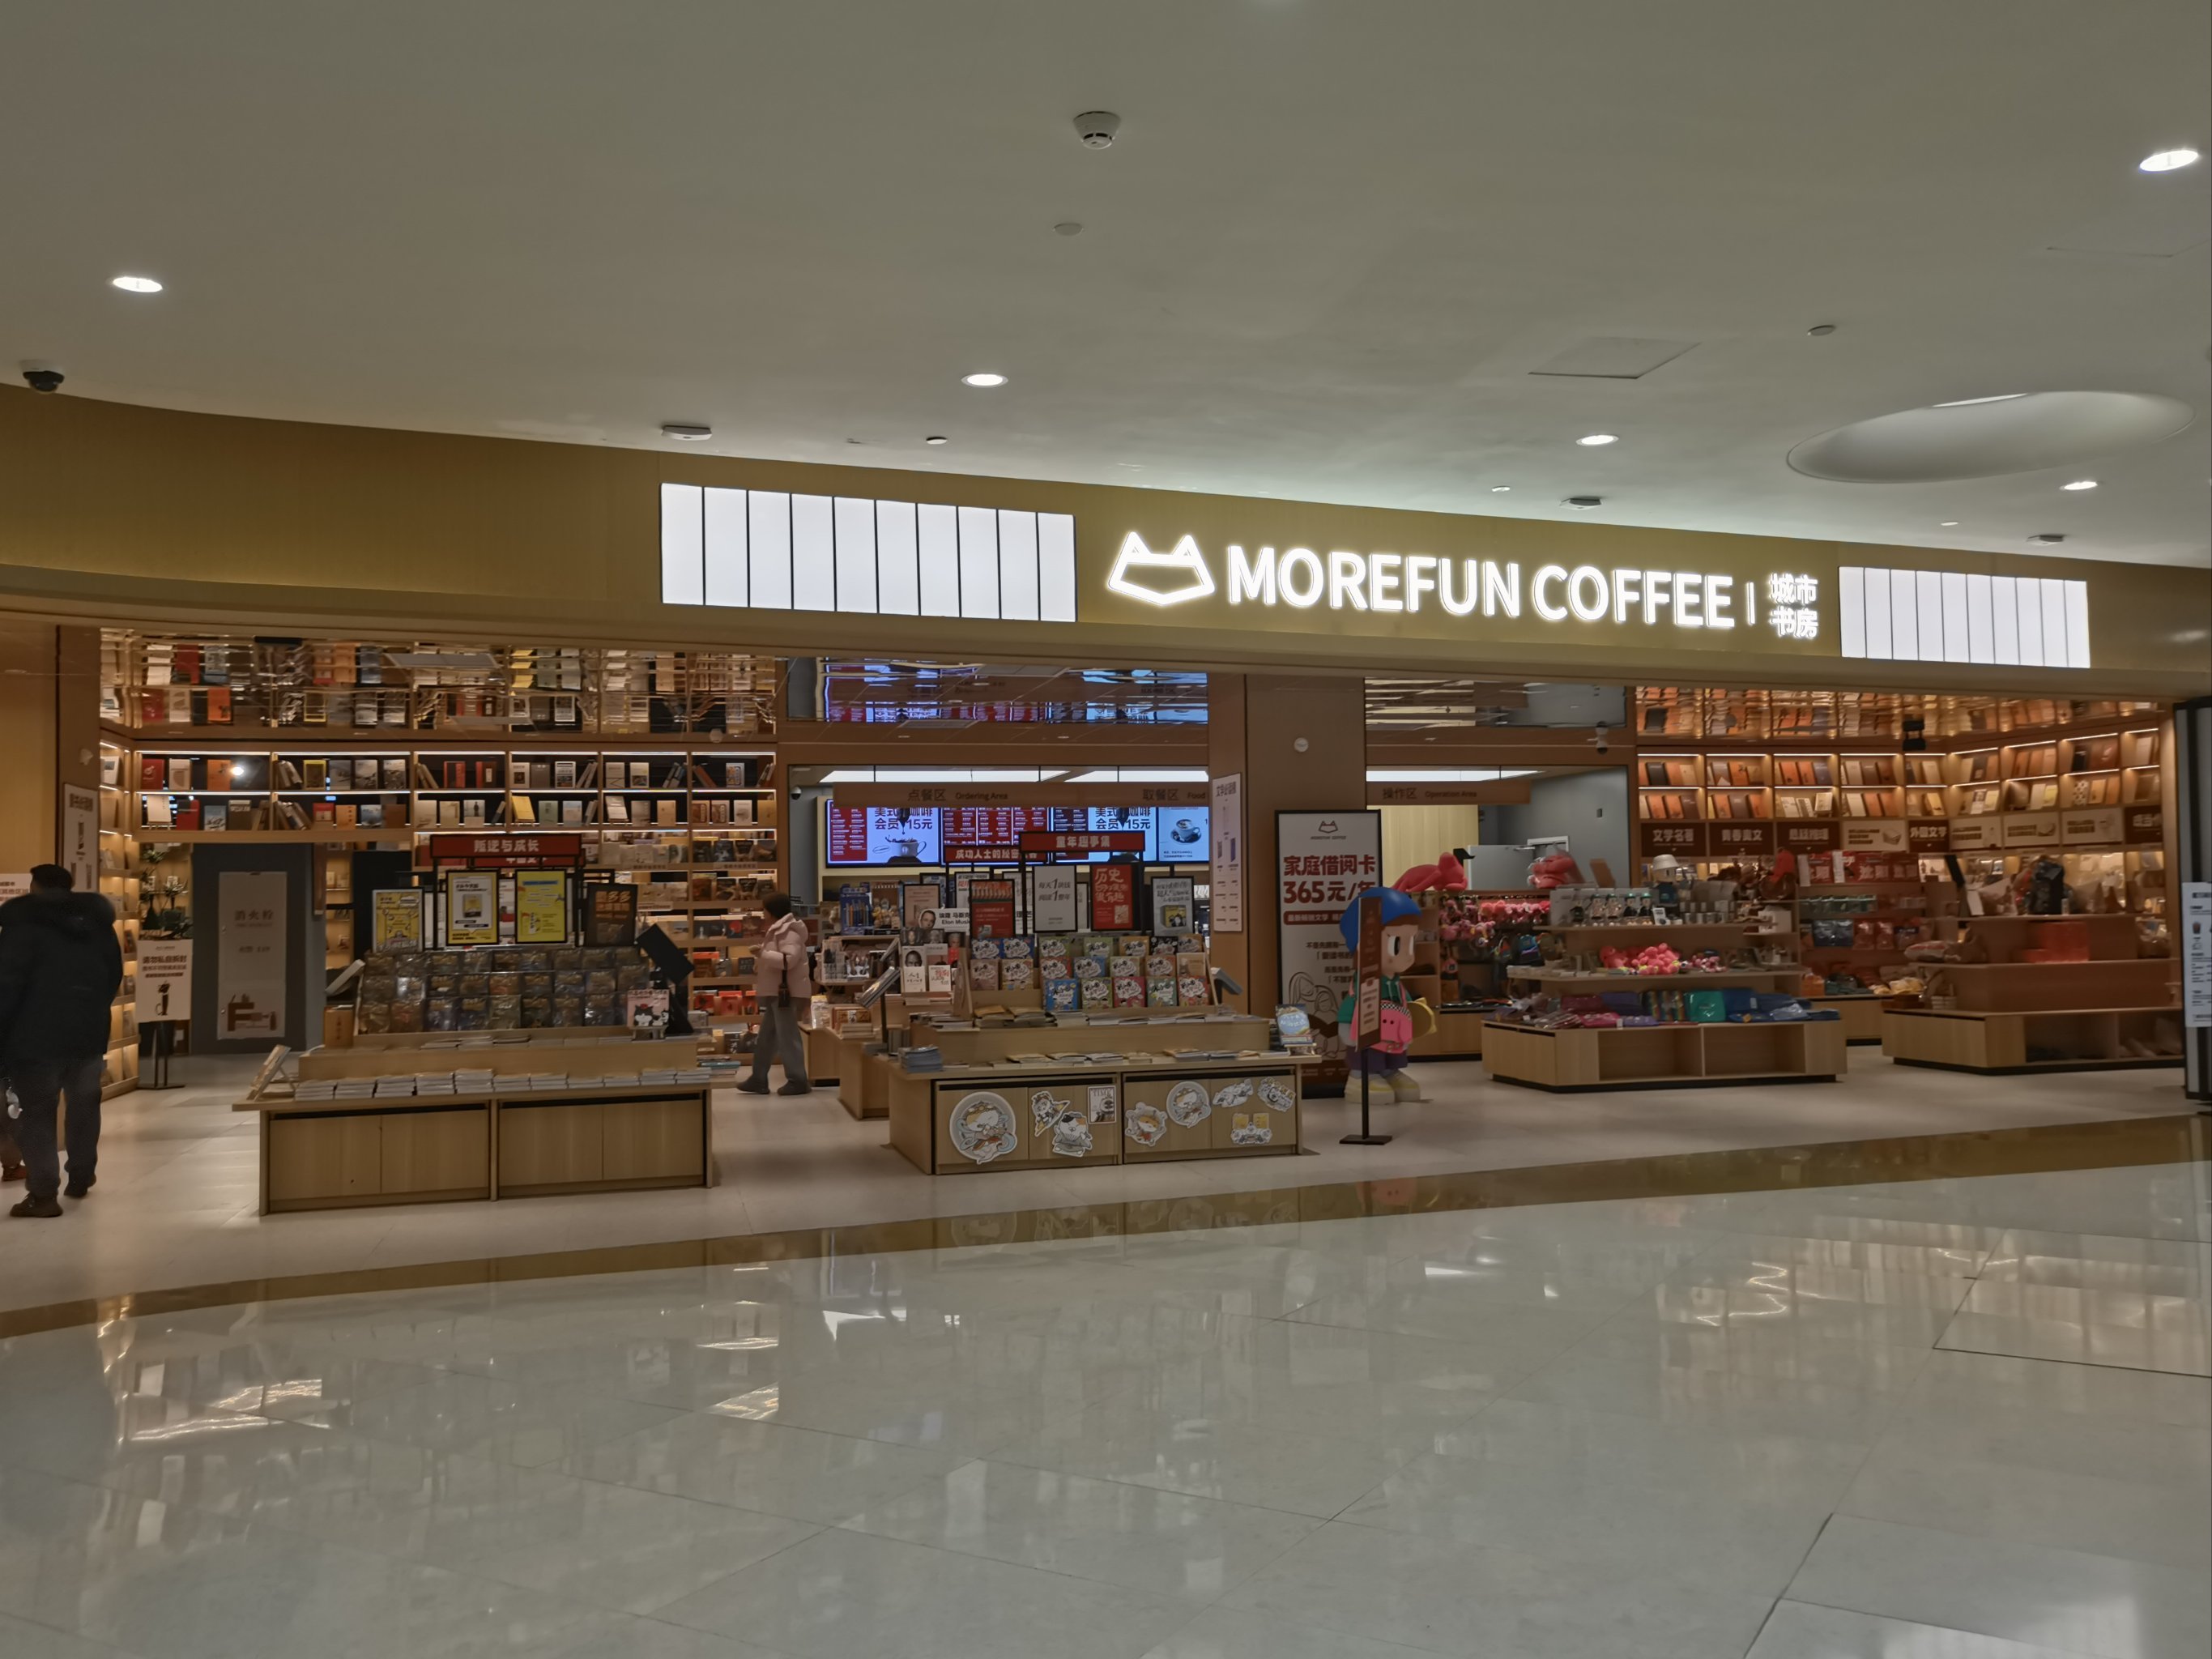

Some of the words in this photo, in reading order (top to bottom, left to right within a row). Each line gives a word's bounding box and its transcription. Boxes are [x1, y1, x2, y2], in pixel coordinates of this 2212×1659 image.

[1227, 544, 1519, 619] MOREFUN
[1532, 564, 1735, 629] COFFEE
[1769, 572, 1818, 604] 城市
[1769, 605, 1818, 638] 书房
[907, 789, 947, 801] 点餐区
[955, 791, 990, 801] Ordering
[1143, 789, 1179, 800] 取餐区
[1383, 788, 1417, 800] 操作区
[1652, 829, 1694, 842] 文学名著
[474, 839, 539, 852] 叛逆与成长
[955, 848, 1038, 859] 成功人士的秘密
[1284, 855, 1376, 876] 家庭借阅卡
